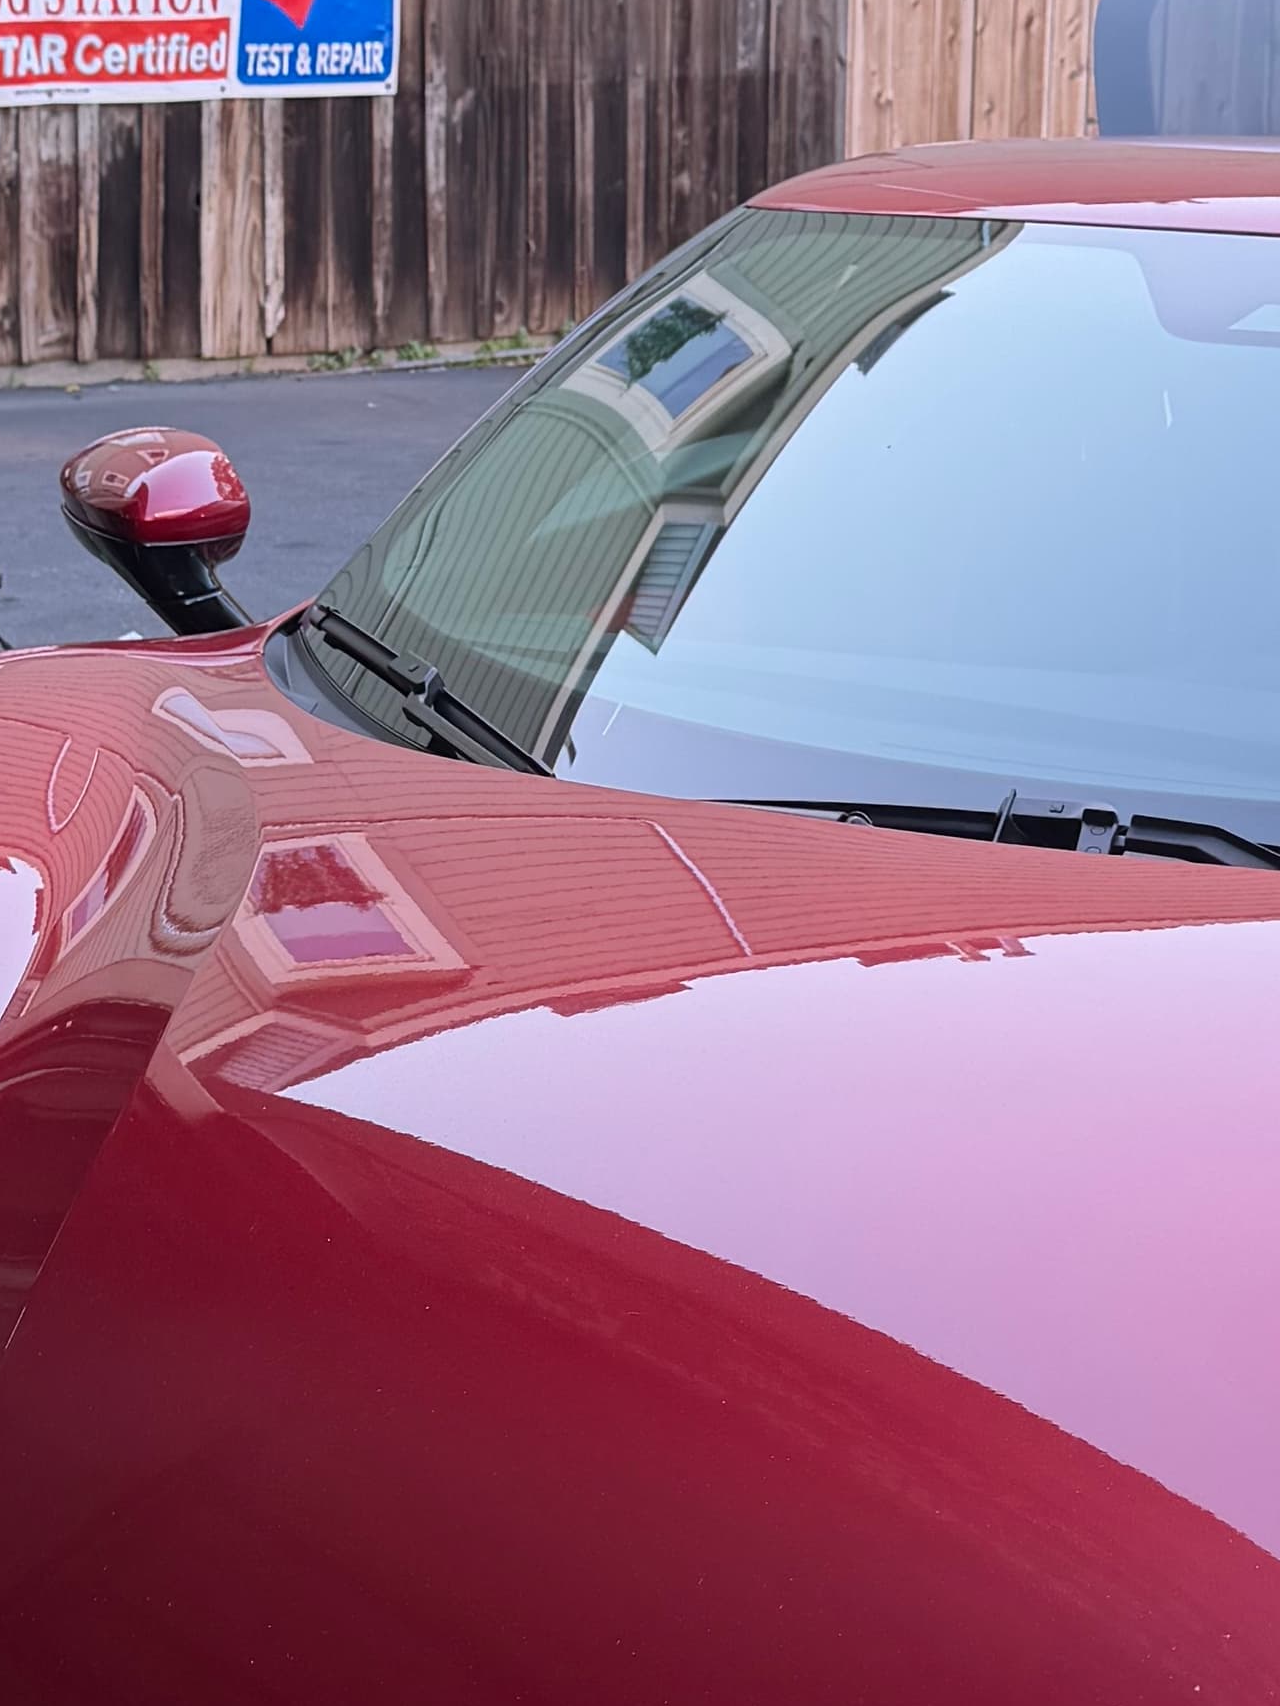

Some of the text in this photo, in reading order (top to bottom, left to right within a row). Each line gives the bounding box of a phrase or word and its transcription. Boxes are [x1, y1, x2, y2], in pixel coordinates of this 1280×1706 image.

[74, 30, 227, 76] Certified
[245, 40, 385, 77] TEST & REPAIR
